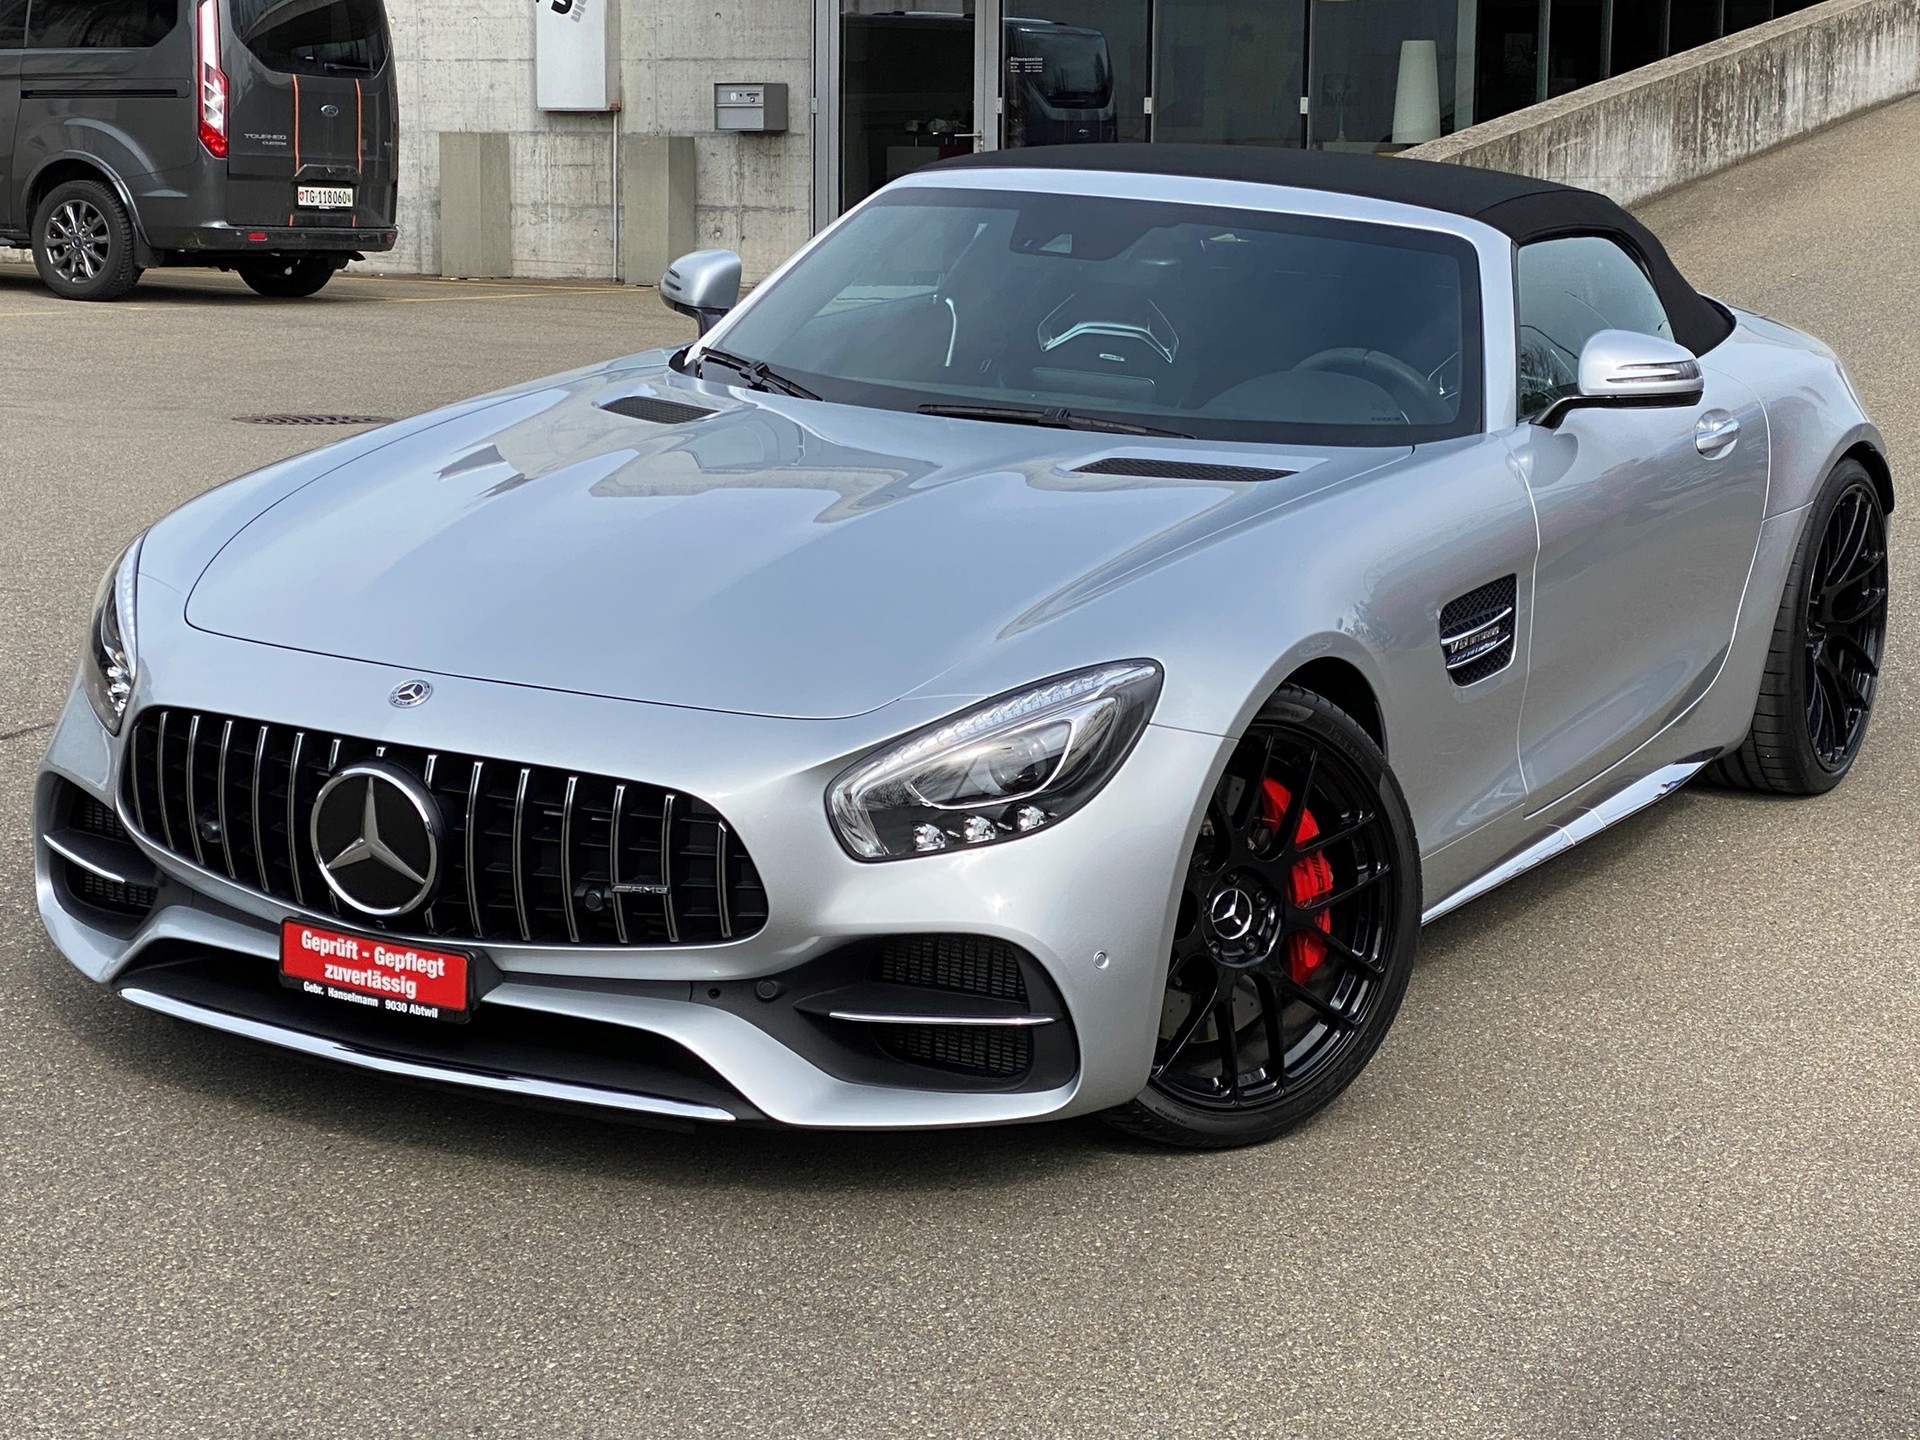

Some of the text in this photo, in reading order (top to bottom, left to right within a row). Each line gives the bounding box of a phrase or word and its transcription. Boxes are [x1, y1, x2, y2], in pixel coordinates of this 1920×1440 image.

[301, 929, 446, 979] Geprüft - Gepflegt
[303, 981, 439, 1020] Gebr. Hanselmann 9030 Abtwil
[324, 963, 418, 1001] zuverlässig
